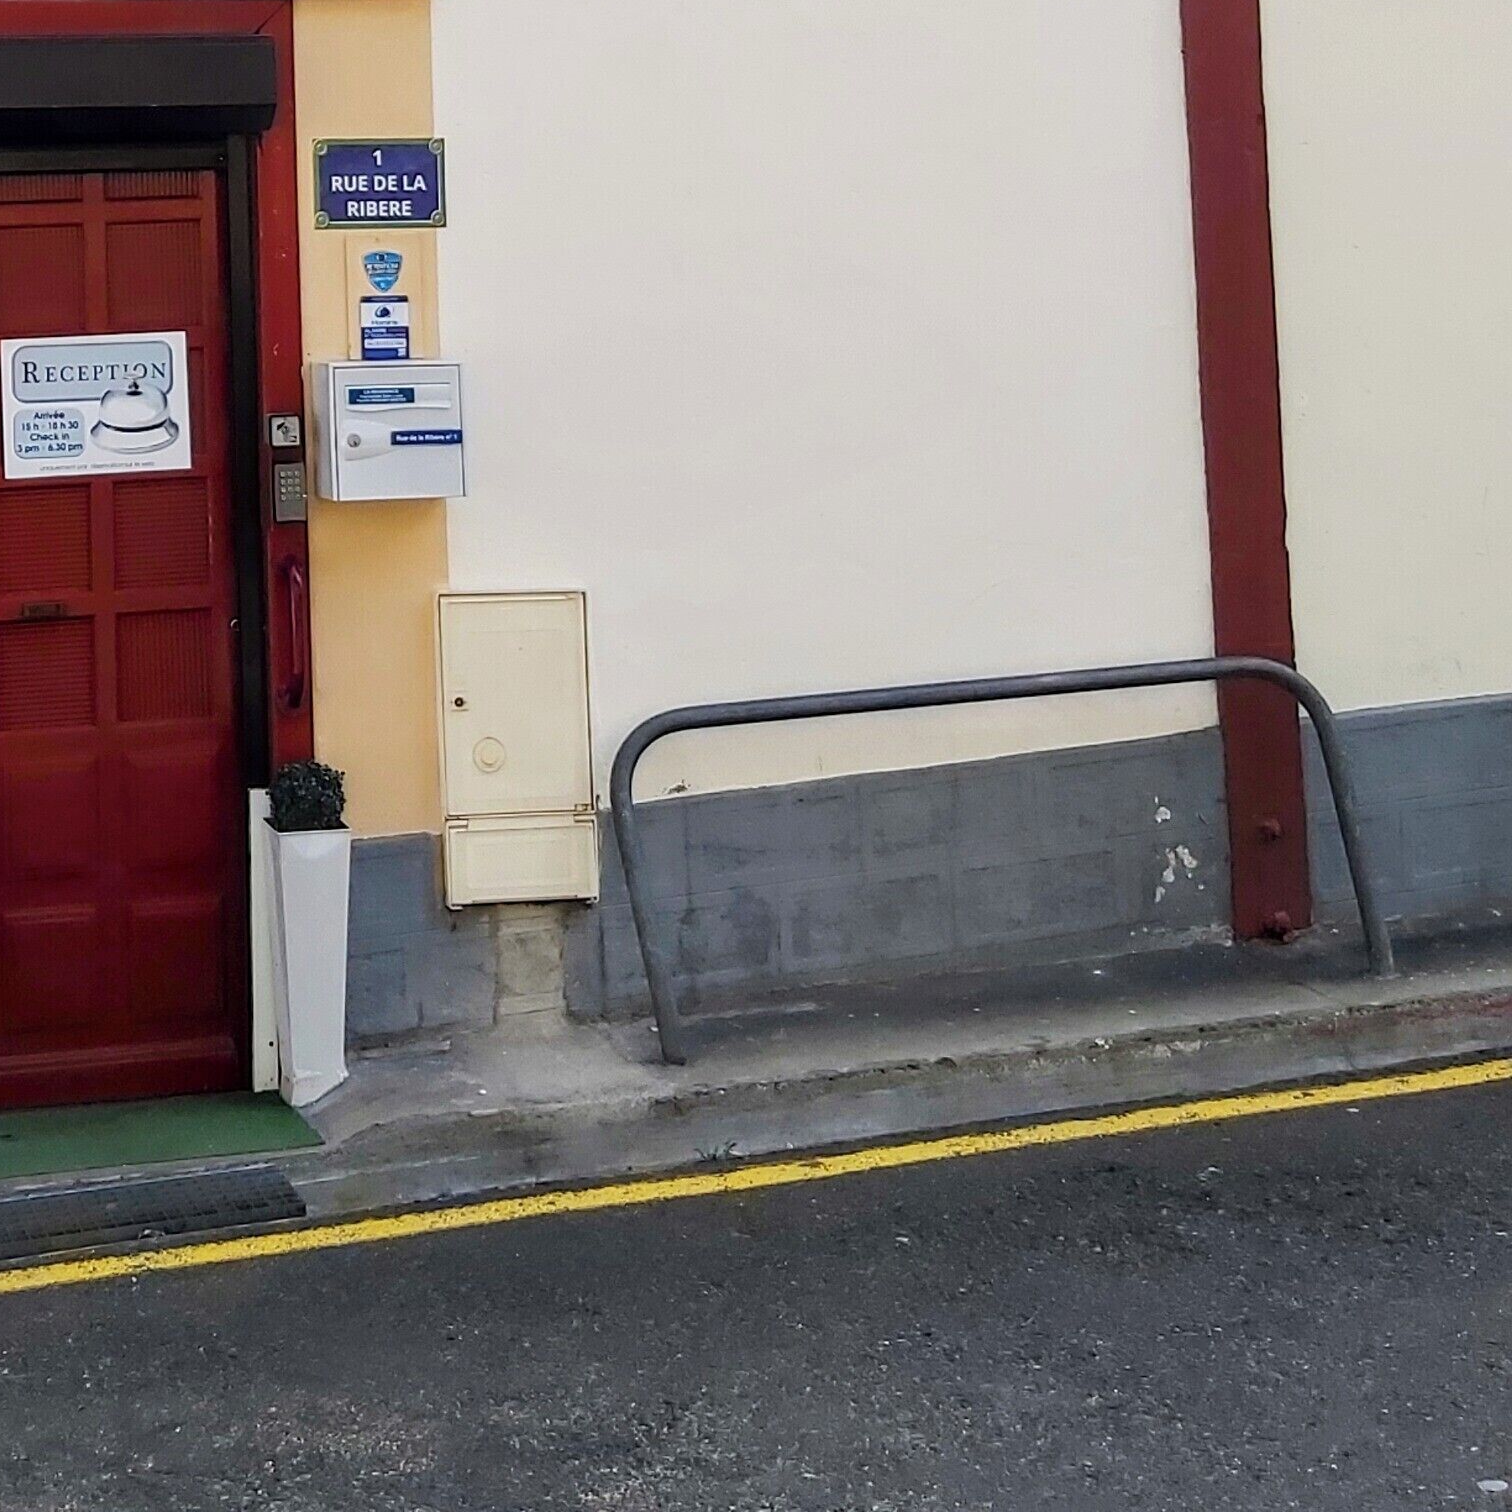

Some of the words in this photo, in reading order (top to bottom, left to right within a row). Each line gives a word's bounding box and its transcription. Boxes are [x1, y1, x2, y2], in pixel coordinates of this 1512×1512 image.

[372, 150, 382, 166] 1
[331, 175, 368, 191] RUE
[374, 175, 397, 191] DE
[403, 175, 427, 191] LA
[347, 200, 412, 217] RIBERE
[21, 361, 167, 384] RECEPTION
[68, 421, 79, 429] 30
